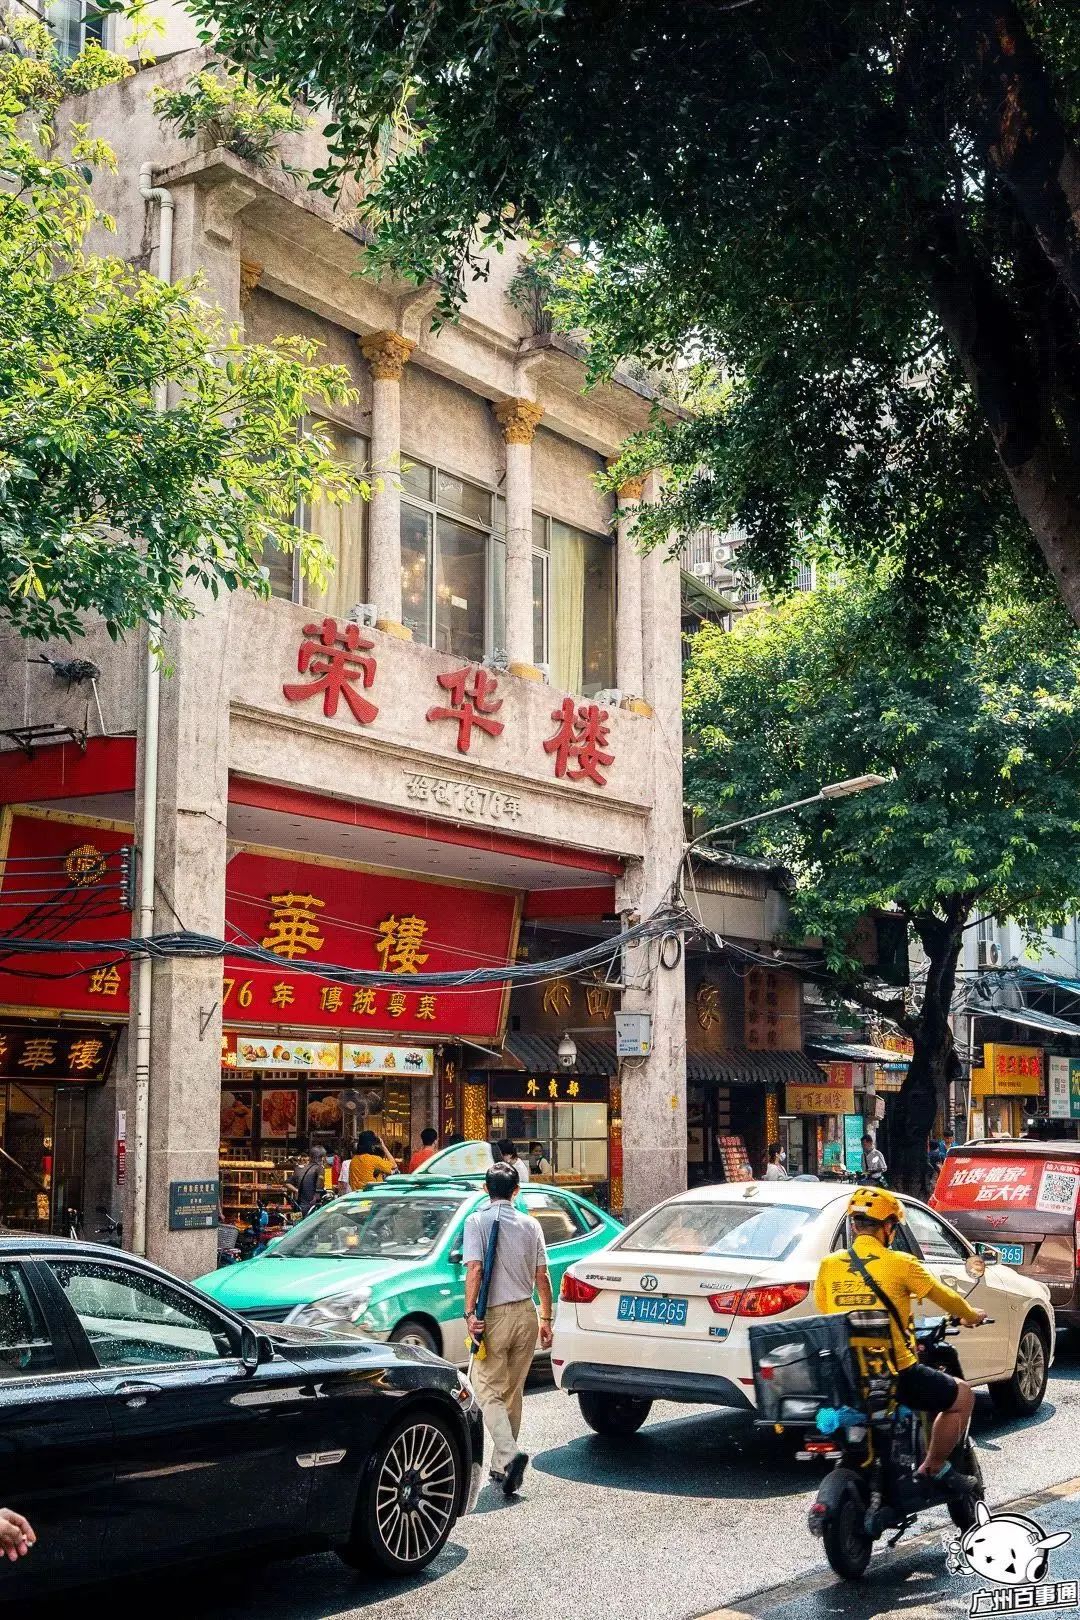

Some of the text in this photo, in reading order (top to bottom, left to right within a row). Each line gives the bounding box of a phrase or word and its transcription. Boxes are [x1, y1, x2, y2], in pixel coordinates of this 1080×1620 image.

[283, 617, 616, 786] 荣华楼
[974, 1184, 1032, 1202] 运大件
